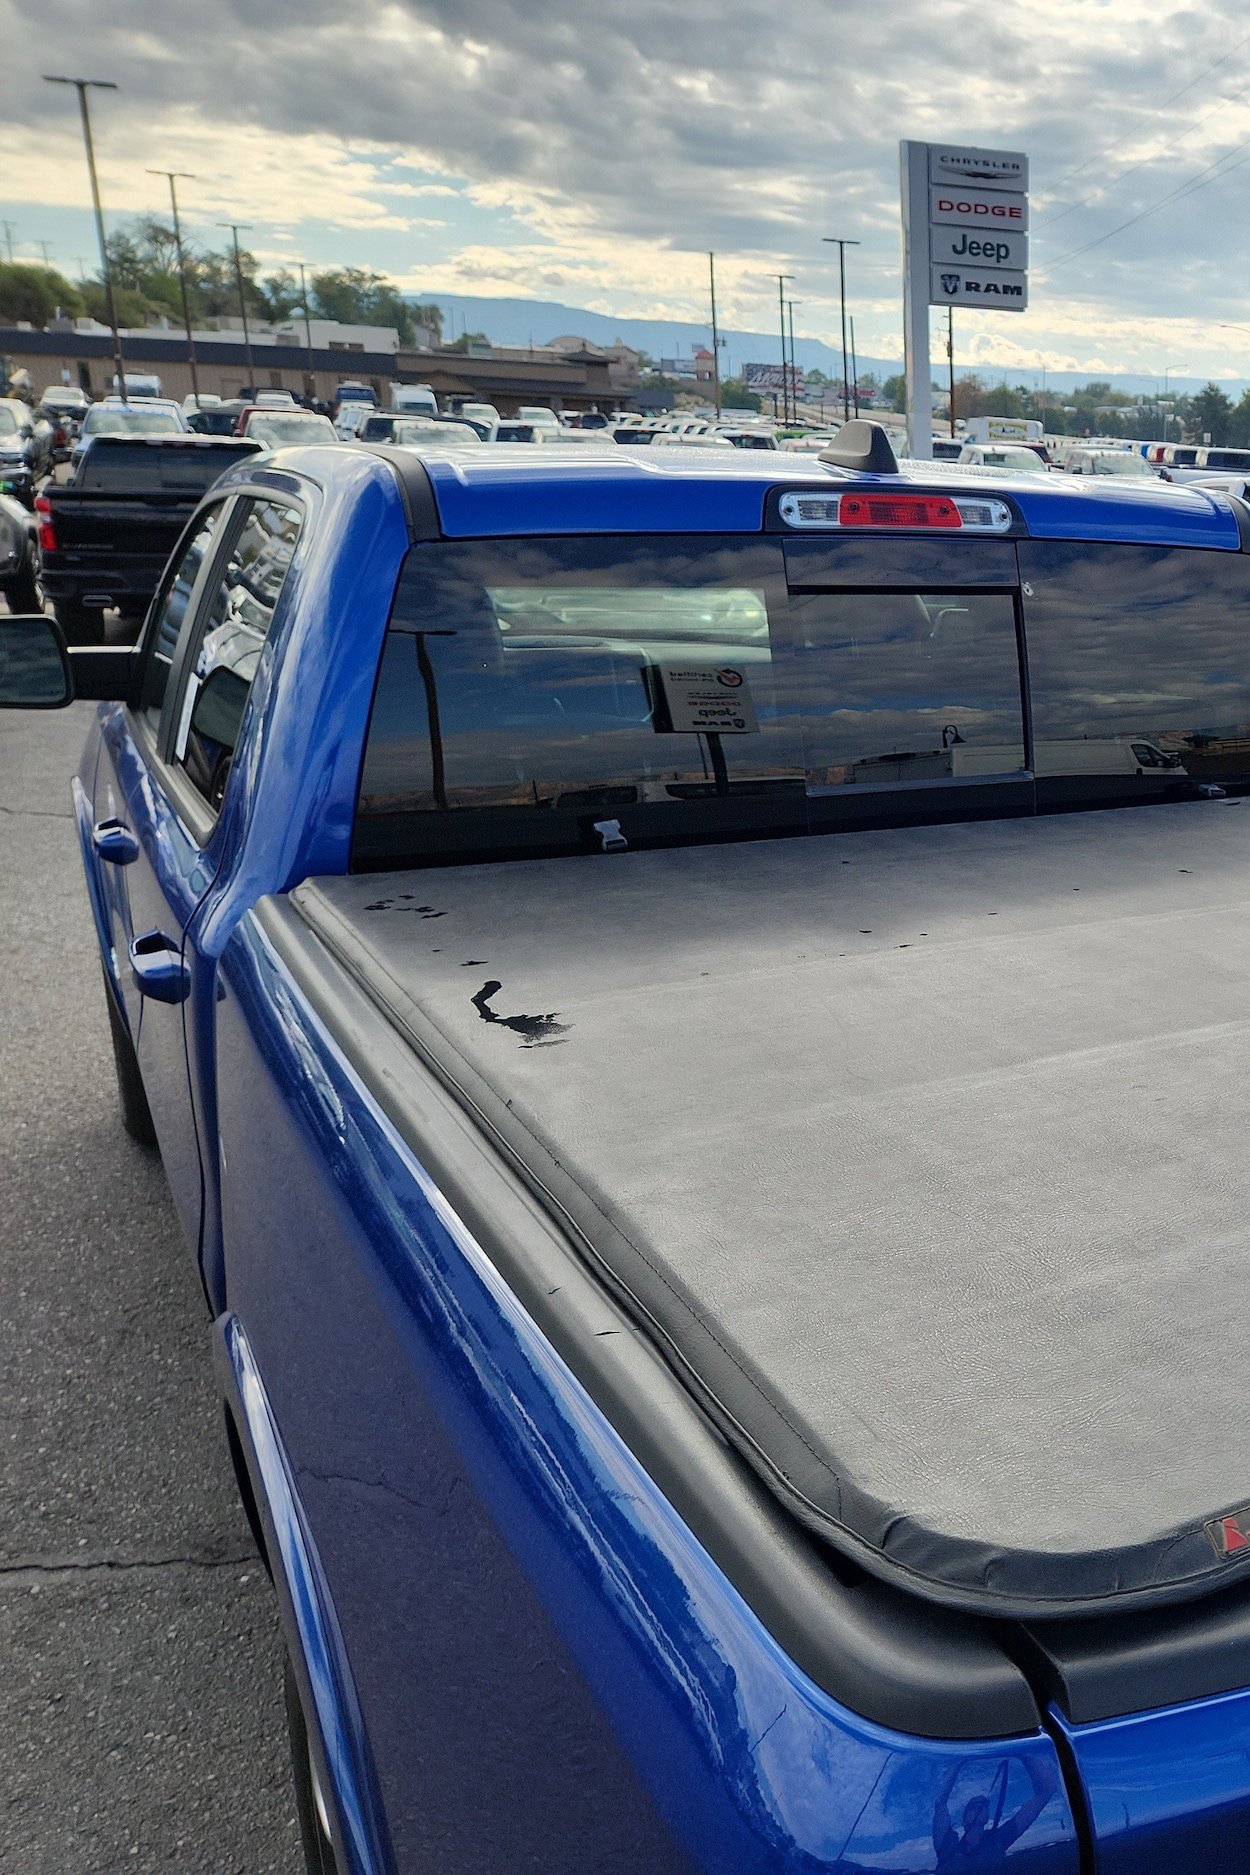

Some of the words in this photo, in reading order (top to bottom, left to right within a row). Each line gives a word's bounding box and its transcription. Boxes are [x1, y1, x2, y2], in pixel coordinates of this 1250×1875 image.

[940, 155, 1021, 170] CHRYSLER
[938, 200, 1023, 218] DODGE
[952, 233, 1010, 263] Jeep
[965, 281, 1023, 296] RAM
